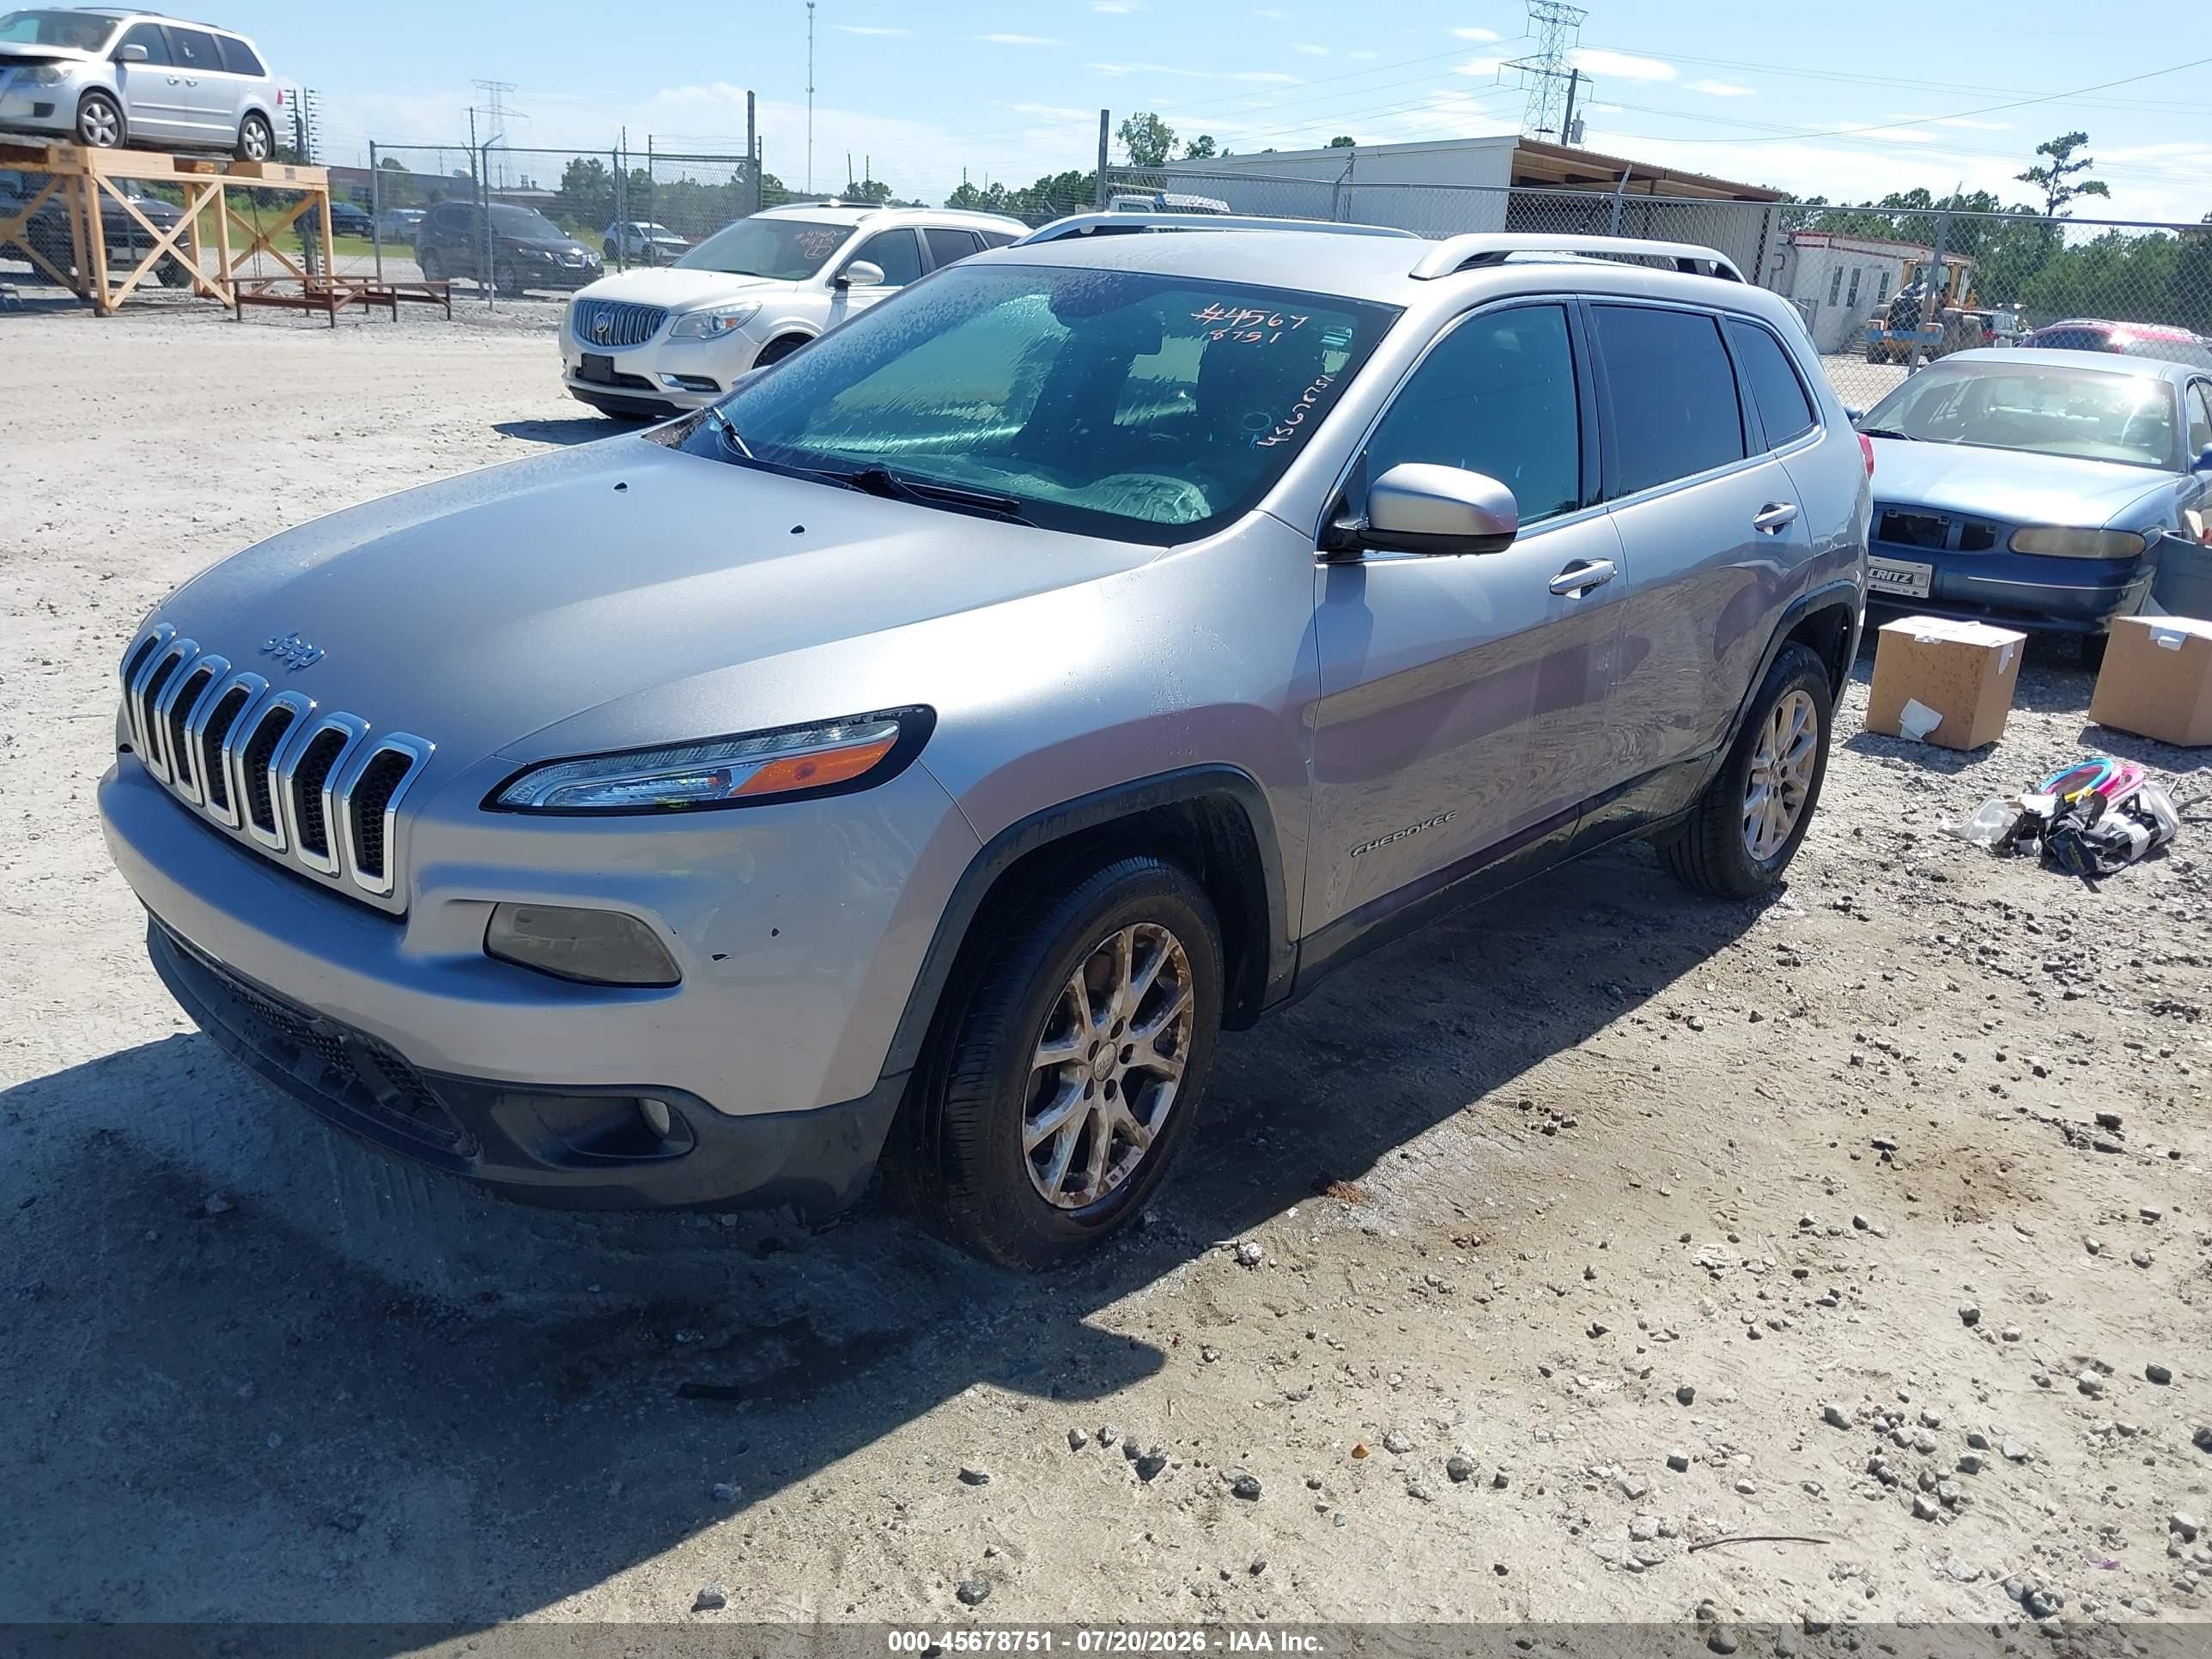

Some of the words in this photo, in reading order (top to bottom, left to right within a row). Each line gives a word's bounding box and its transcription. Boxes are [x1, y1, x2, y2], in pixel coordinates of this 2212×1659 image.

[1209, 328, 1284, 344] 8751
[1257, 374, 1335, 447] 45678751
[1869, 568, 1912, 584] CRITZ
[1351, 811, 1457, 858] CHEROKEE
